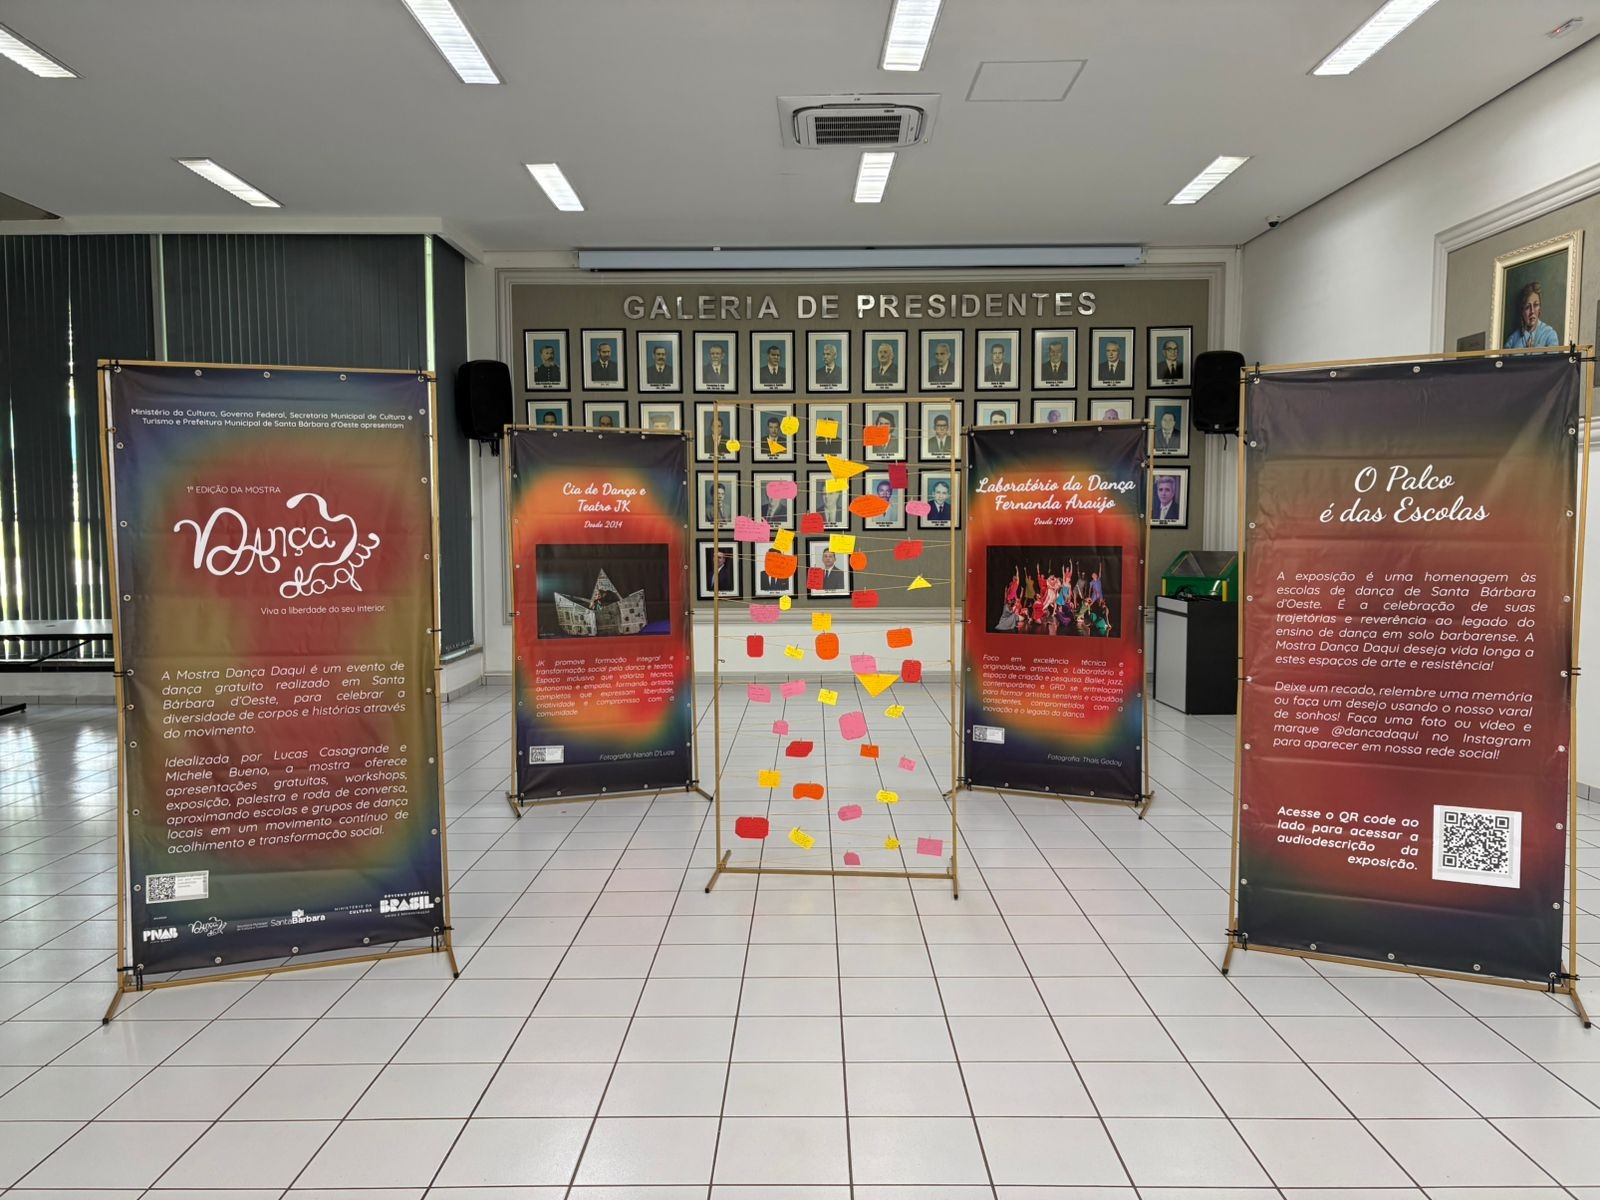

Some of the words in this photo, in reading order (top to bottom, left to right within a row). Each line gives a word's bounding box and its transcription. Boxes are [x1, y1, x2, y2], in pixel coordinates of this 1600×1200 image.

[624, 295, 779, 320] GALERIA
[797, 295, 839, 320] DE
[857, 291, 1097, 319] PRESIDENTES
[131, 408, 170, 416] Ministério
[186, 410, 218, 418] Cultura,
[256, 411, 287, 419] Federal,
[183, 418, 222, 426] Prefeitura
[225, 420, 260, 428] Municipal
[976, 477, 1059, 493] Laboratório
[1063, 476, 1083, 491] da
[1088, 474, 1136, 493] Dança
[1354, 466, 1378, 493] O
[1386, 465, 1456, 493] Palco
[196, 485, 229, 494] EDIÇÃO
[231, 486, 243, 494] DA
[245, 486, 281, 494] MOSTRA
[563, 482, 582, 496] Cia
[585, 483, 599, 495] de
[603, 483, 637, 498] Dança
[640, 488, 647, 496] e
[578, 499, 612, 512] Teatro
[614, 501, 631, 513] JK
[995, 494, 1062, 511] Fernanda
[1065, 494, 1116, 513] Araújo
[1320, 503, 1334, 523] é
[1340, 498, 1387, 523] das
[1393, 496, 1490, 523] Escolas
[584, 521, 604, 529] Desde
[605, 521, 624, 529] 2014
[1034, 517, 1053, 526] Desde
[1055, 517, 1074, 526] 1999
[1277, 572, 1285, 580] A
[1296, 572, 1356, 582] exposição
[1366, 572, 1374, 582] é
[1385, 574, 1413, 582] uma
[1424, 572, 1509, 584] homenagem
[1521, 573, 1536, 583] às
[1277, 585, 1320, 595] escolas
[1330, 586, 1346, 595] de
[1355, 586, 1394, 597] dança
[1404, 586, 1421, 596] de
[1431, 586, 1470, 597] Santa
[1480, 587, 1536, 598] Bárbara
[289, 606, 327, 614] liberdade
[1338, 598, 1346, 610] É
[1360, 602, 1368, 610] a
[1383, 600, 1455, 612] celebração
[1471, 601, 1488, 612] de
[1504, 604, 1536, 612] suas
[1277, 614, 1336, 624] trajetórias
[1345, 616, 1352, 624] e
[1361, 615, 1426, 625] reverência
[1435, 618, 1452, 626] ao
[1462, 616, 1508, 629] legado
[1517, 617, 1535, 628] do
[1276, 628, 1314, 637] ensino
[1319, 628, 1334, 637] de
[1339, 628, 1377, 639] dança
[1382, 631, 1402, 639] em
[1408, 630, 1434, 640] solo
[1440, 630, 1518, 642] barbarense.
[1524, 633, 1534, 642] A
[1276, 640, 1316, 651] Mostra
[1320, 642, 1359, 653] Dança
[1363, 643, 1400, 655] Daqui
[1403, 644, 1446, 656] deseja
[1451, 645, 1478, 656] vida
[1483, 646, 1521, 659] longa
[1525, 649, 1534, 657] a
[161, 671, 170, 680] A
[177, 670, 220, 680] Mostra
[226, 668, 265, 678] Dança
[271, 665, 306, 677] Daqui
[310, 665, 318, 674] é
[323, 666, 342, 674] um
[346, 663, 386, 672] evento
[390, 661, 405, 671] de
[1275, 655, 1305, 664] estes
[1309, 657, 1358, 667] espaços
[1361, 657, 1377, 667] de
[1380, 659, 1406, 668] arte
[1410, 660, 1418, 668] e
[1421, 660, 1494, 671] resistência!
[162, 685, 202, 696] dança
[215, 682, 264, 695] gratuito
[276, 678, 330, 689] realizado
[372, 675, 405, 685] Santa
[163, 699, 215, 710] Bárbara
[294, 694, 322, 705] para
[337, 690, 384, 701] celebrar
[398, 690, 405, 698] a
[163, 711, 236, 724] diversidade
[239, 710, 254, 720] de
[258, 709, 299, 720] corpos
[312, 705, 360, 716] histórias
[363, 703, 406, 713] através
[164, 728, 181, 739] do
[184, 725, 256, 737] movimento.
[1278, 806, 1321, 818] Acesse
[1326, 812, 1334, 820] o
[1339, 811, 1359, 823] QR
[1364, 815, 1396, 825] code
[1402, 819, 1419, 827] ao
[1278, 819, 1305, 831] lado
[1312, 825, 1342, 834] para
[1350, 828, 1403, 840] acessar
[1410, 834, 1419, 842] a
[1277, 835, 1375, 852] audiodescrição
[1401, 845, 1418, 856] da
[1348, 856, 1417, 870] exposição.
[379, 895, 435, 914] BRASIL
